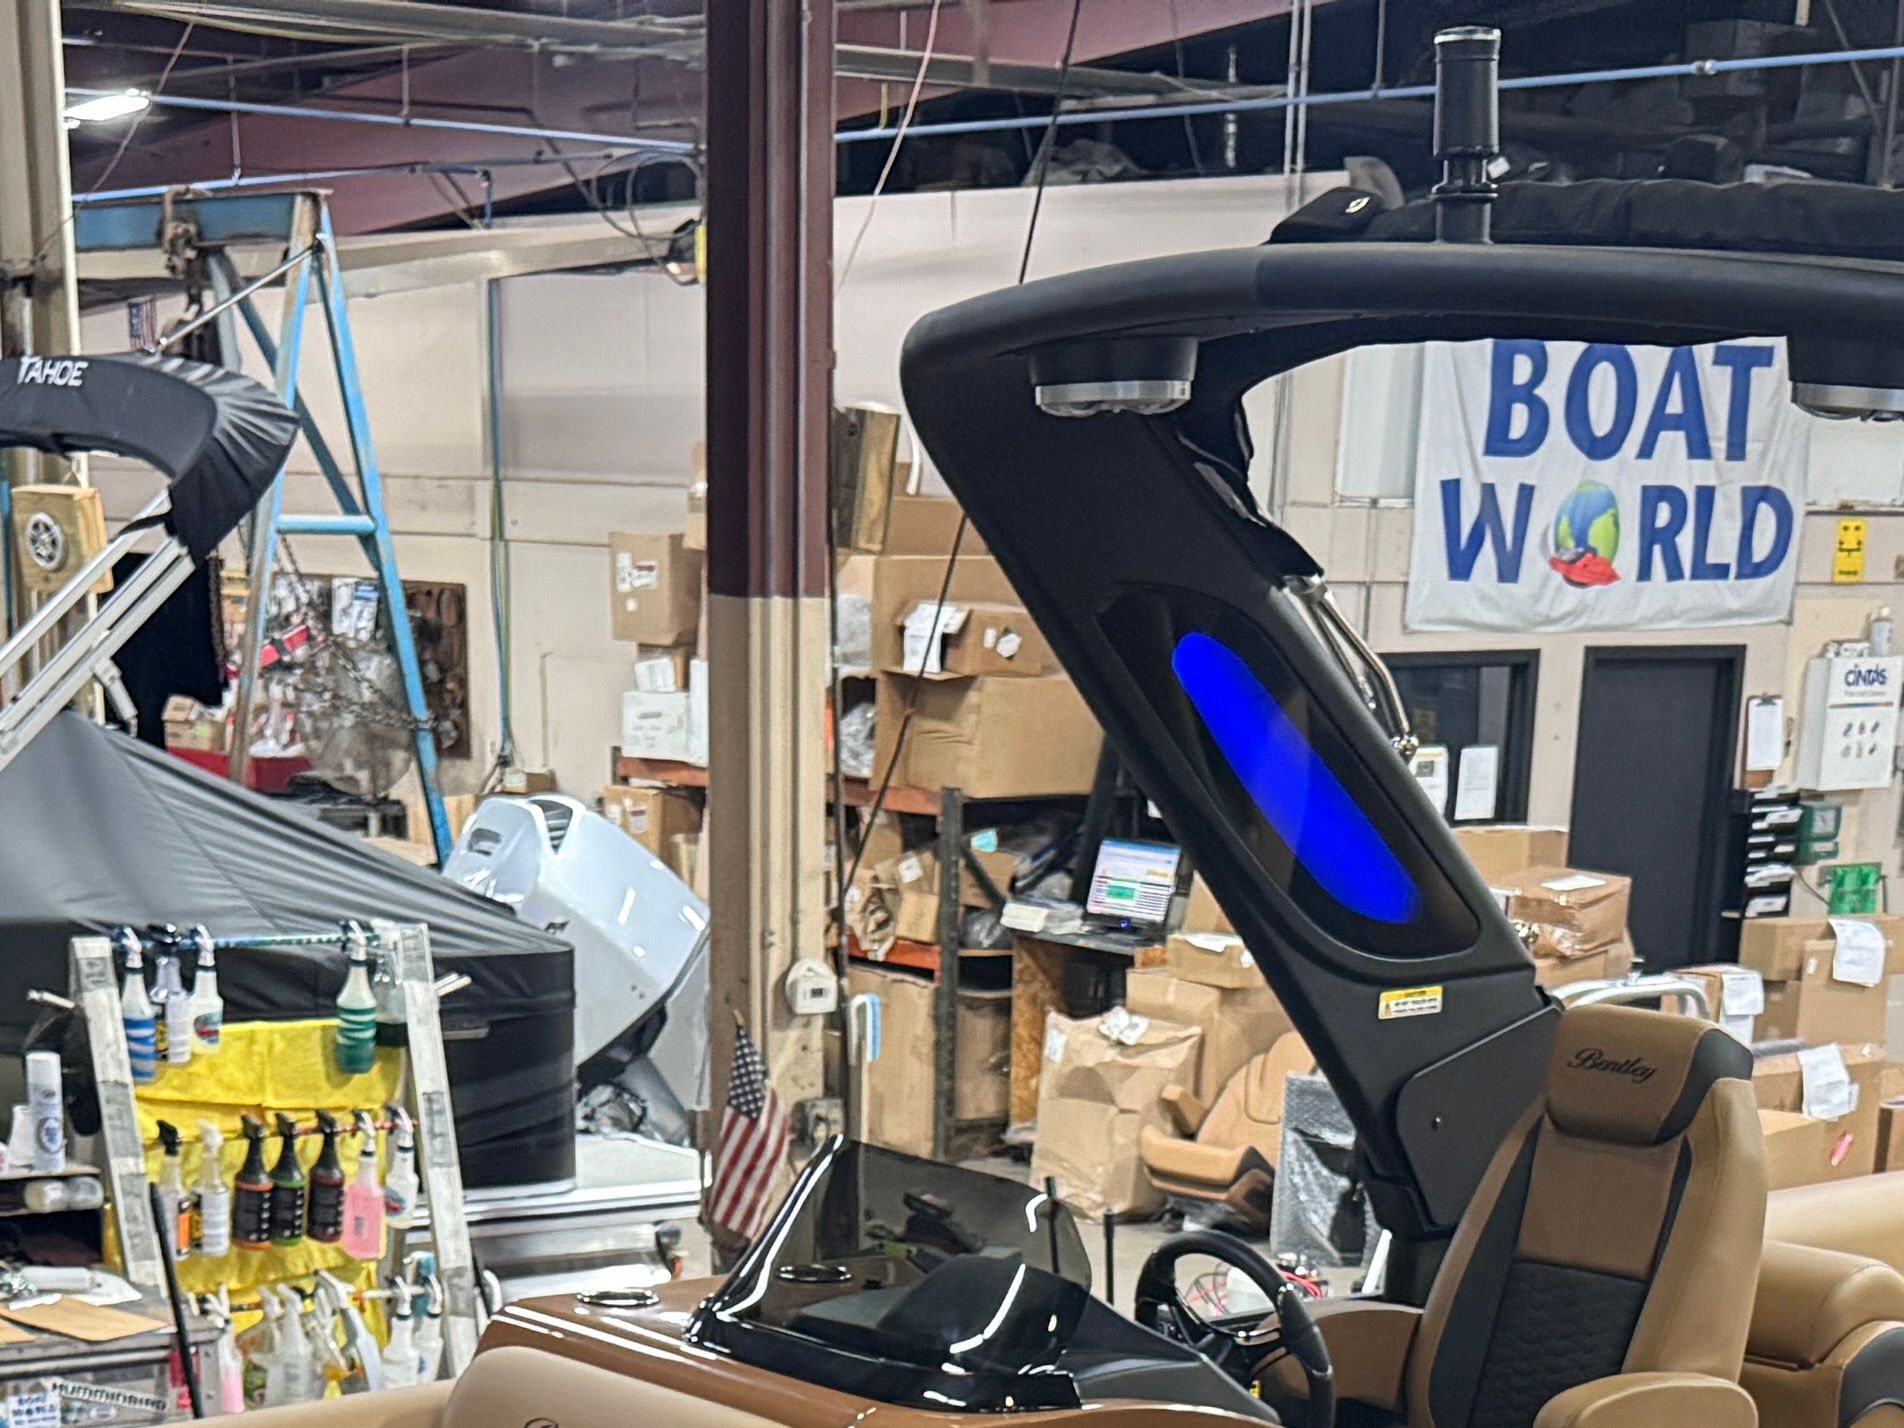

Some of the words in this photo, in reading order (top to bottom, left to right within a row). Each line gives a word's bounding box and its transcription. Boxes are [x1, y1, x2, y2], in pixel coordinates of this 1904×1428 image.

[17, 355, 89, 387] TAHOE
[1483, 338, 1775, 462] BOAT
[1566, 1048, 1657, 1083] Bentley
